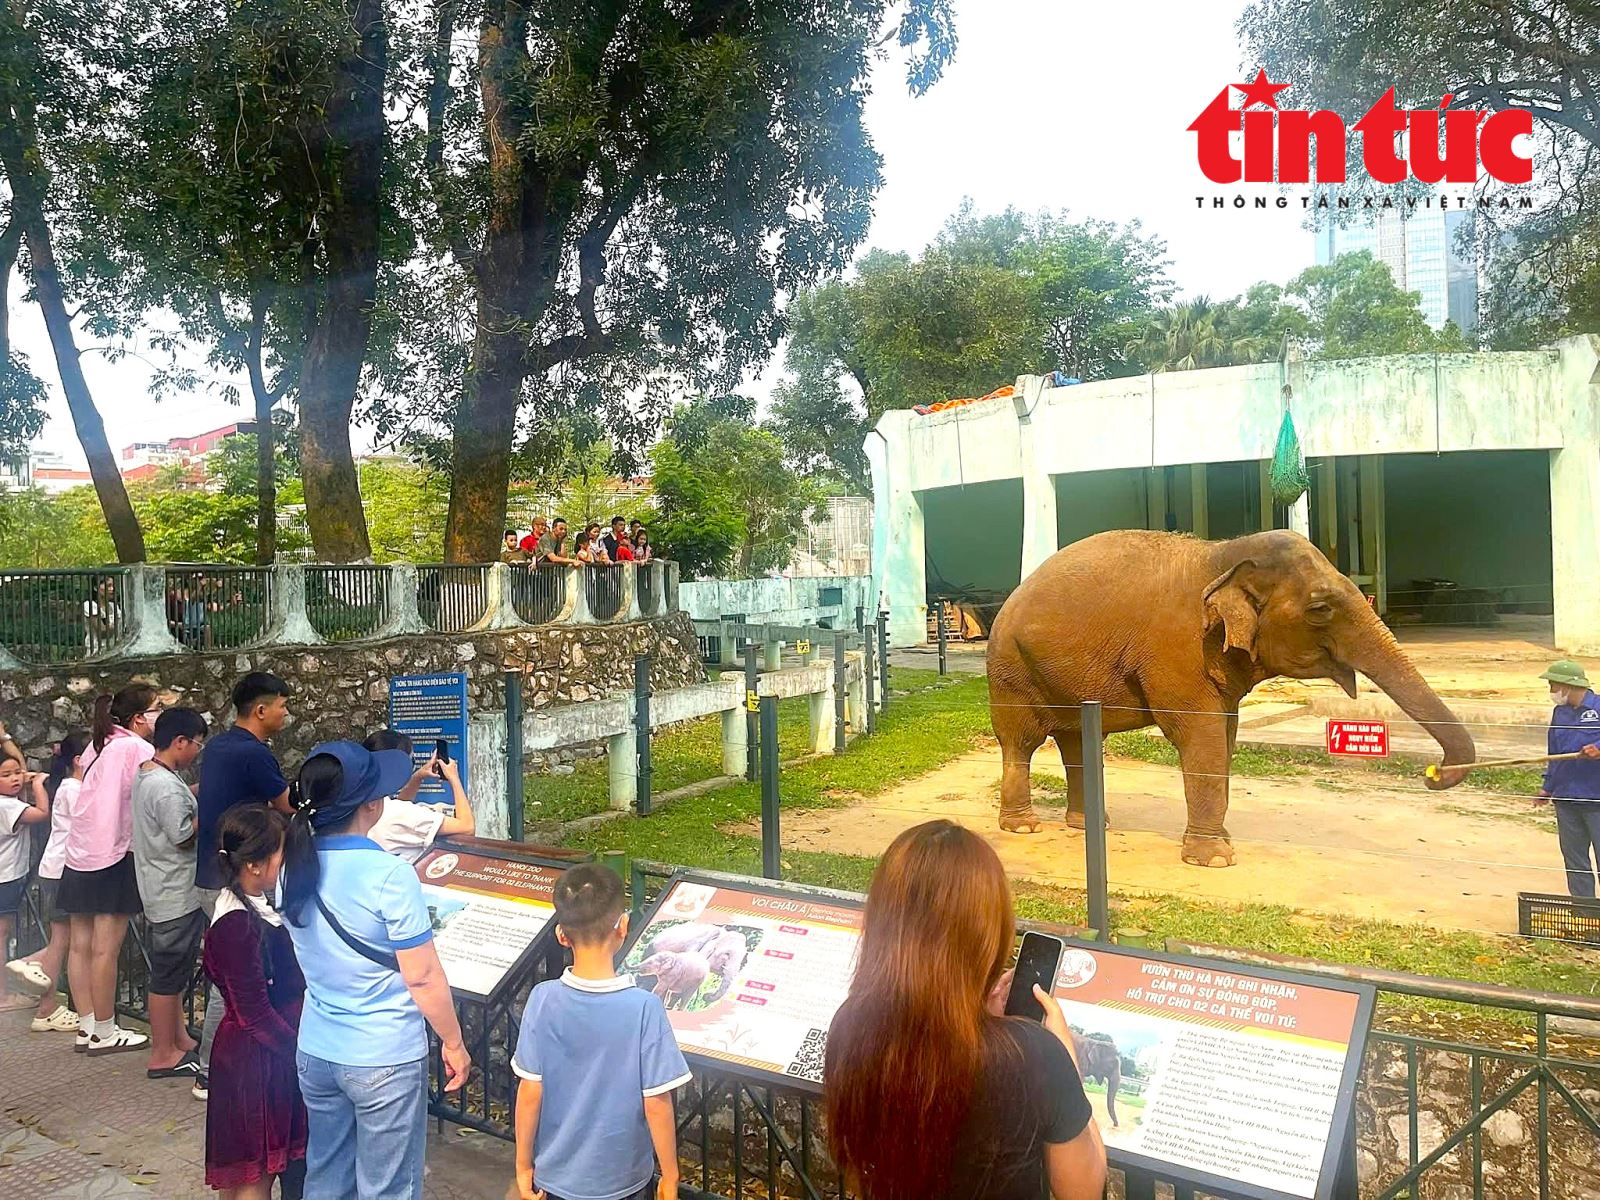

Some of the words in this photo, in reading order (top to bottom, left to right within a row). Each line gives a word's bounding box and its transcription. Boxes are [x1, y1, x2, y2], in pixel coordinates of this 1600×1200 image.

[483, 866, 506, 876] WOULD
[507, 870, 522, 878] LIKE
[522, 872, 531, 880] TO
[531, 874, 555, 883] THANK
[506, 862, 527, 871] HANOI
[464, 871, 494, 882] SUPPORT
[751, 897, 768, 907] VOI
[769, 900, 798, 912] CHÂU
[1141, 963, 1171, 978] VƯỜN
[1196, 972, 1212, 985] HÀ
[1214, 975, 1235, 989] NỘI
[1238, 980, 1258, 993] GHI
[1260, 983, 1298, 1001] NHẬN,
[1151, 977, 1176, 993] CẢM
[1179, 982, 1196, 996] ƠN
[1198, 986, 1216, 1001] SỰ
[1216, 989, 1249, 1006] ĐÓNG
[1145, 991, 1167, 1006] TRỢ
[1168, 995, 1191, 1009] CHO
[1193, 1000, 1208, 1012] 02
[1210, 1002, 1228, 1016] CÁ
[1254, 1012, 1275, 1025] VOI
